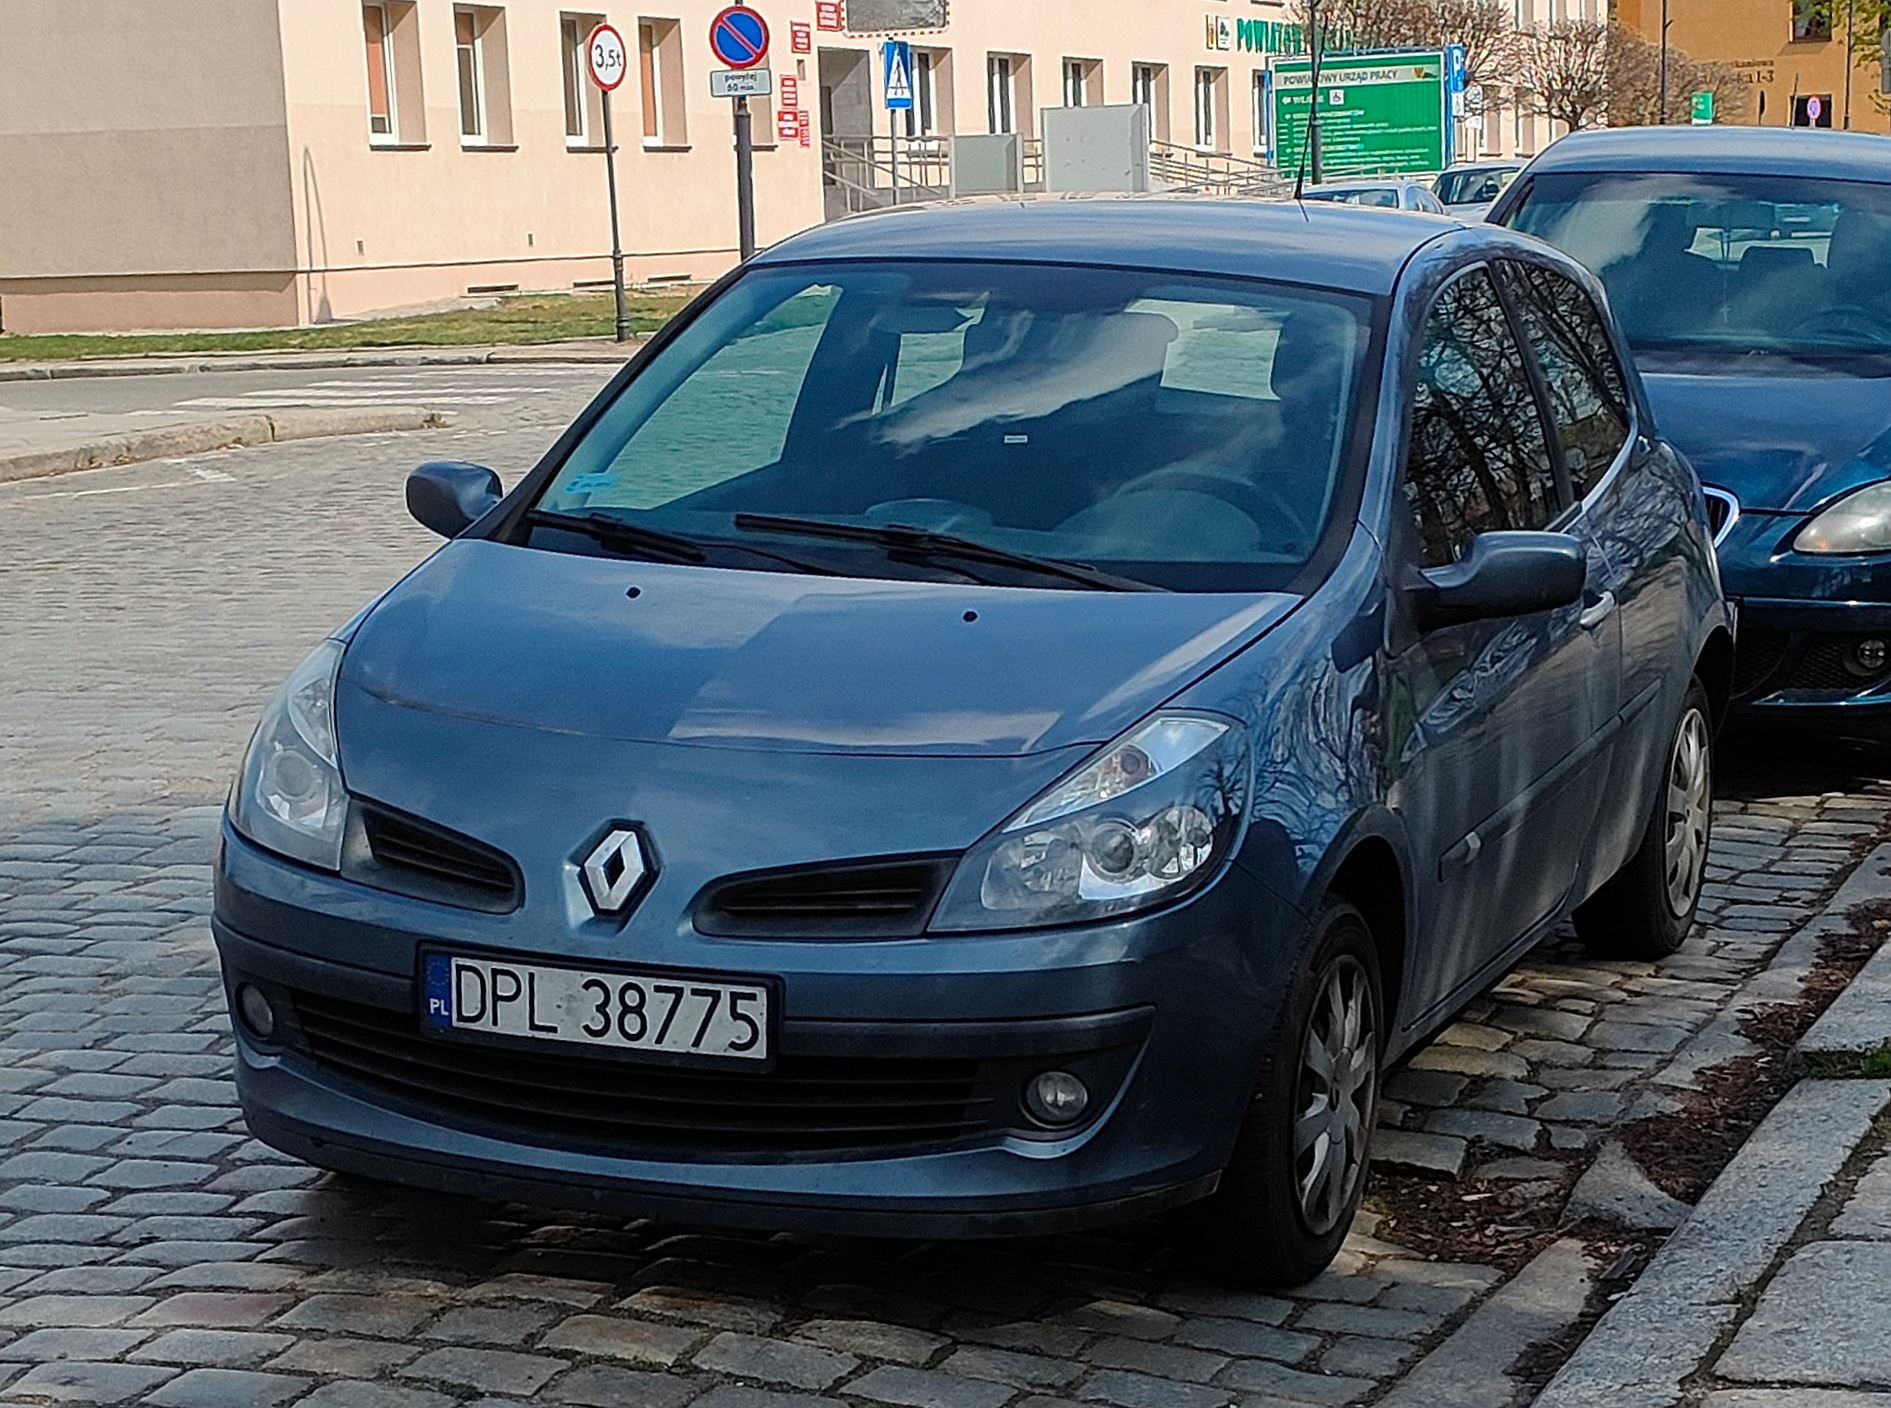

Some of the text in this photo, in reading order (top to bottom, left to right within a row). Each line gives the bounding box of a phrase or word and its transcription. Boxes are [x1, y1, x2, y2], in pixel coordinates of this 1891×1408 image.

[1284, 69, 1397, 86] POWIAOWY URZĄD PRACY
[429, 997, 449, 1017] PL
[455, 962, 759, 1052] DPL 38775
